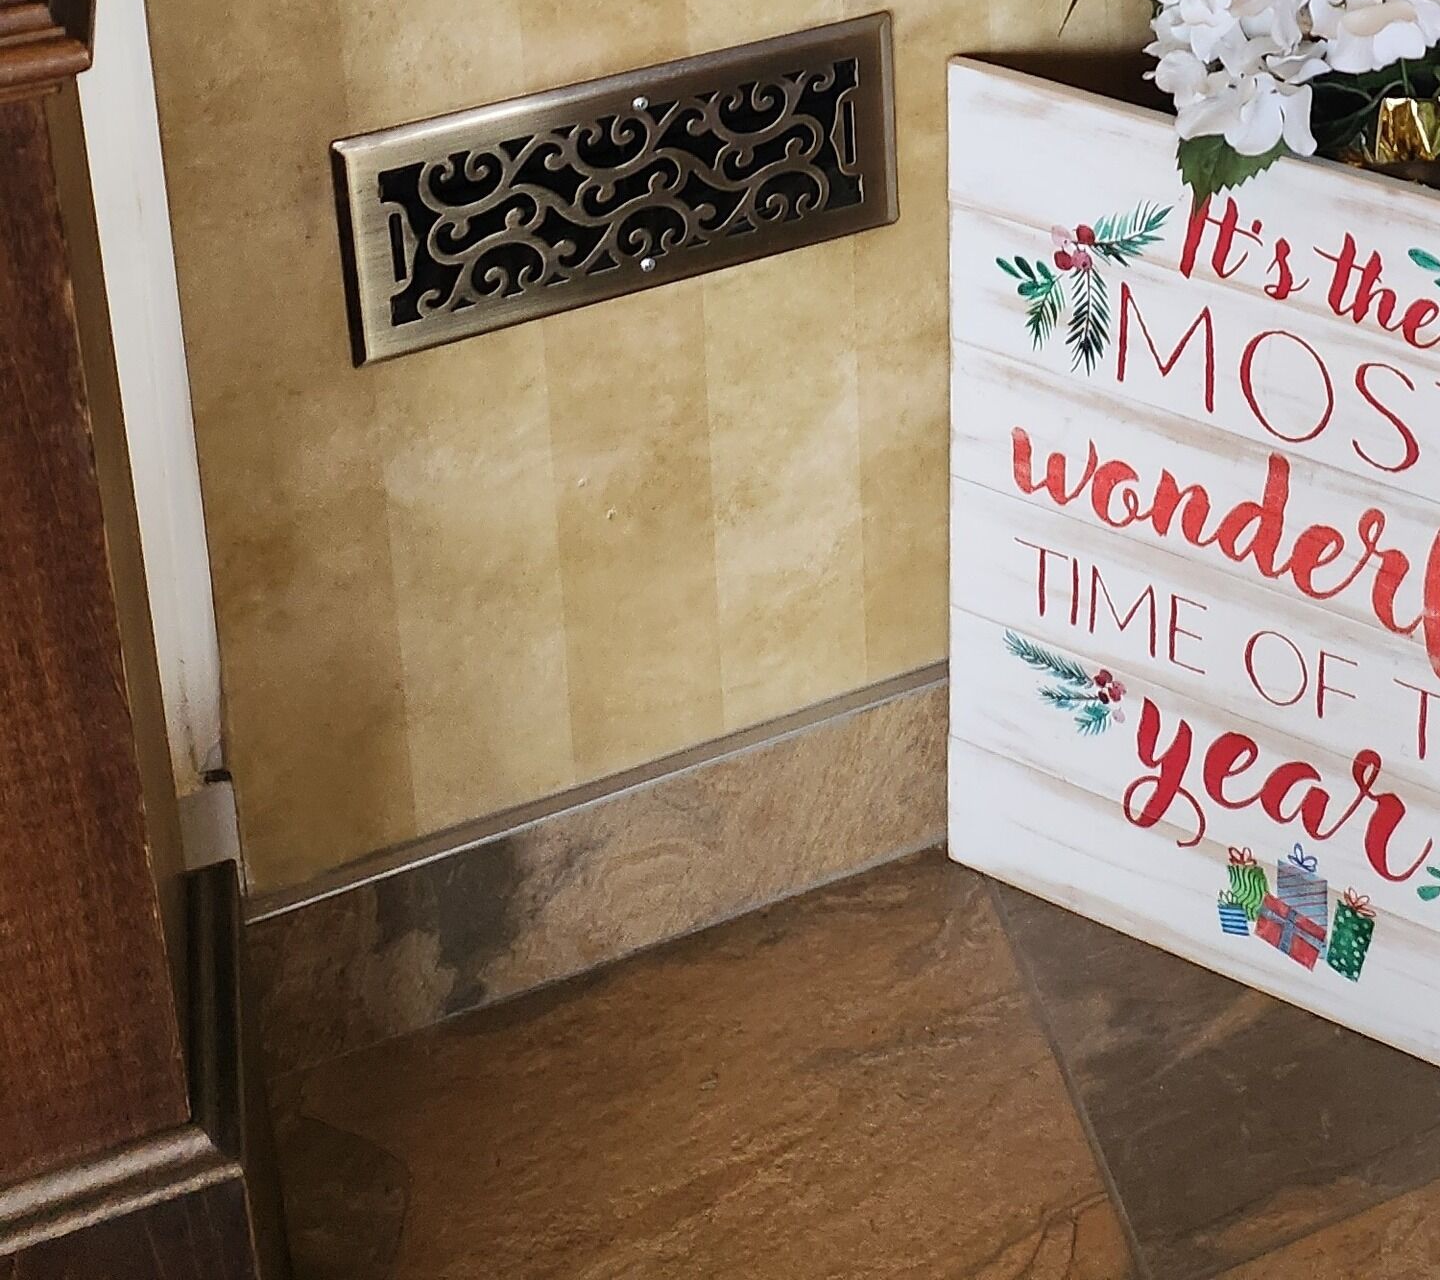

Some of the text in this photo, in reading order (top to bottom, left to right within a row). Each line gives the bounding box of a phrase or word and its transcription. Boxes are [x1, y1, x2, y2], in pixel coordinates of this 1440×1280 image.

[1178, 193, 1310, 301] It's
[1014, 537, 1210, 677] TIME
[1243, 629, 1359, 720] OF
[1123, 697, 1433, 884] year
